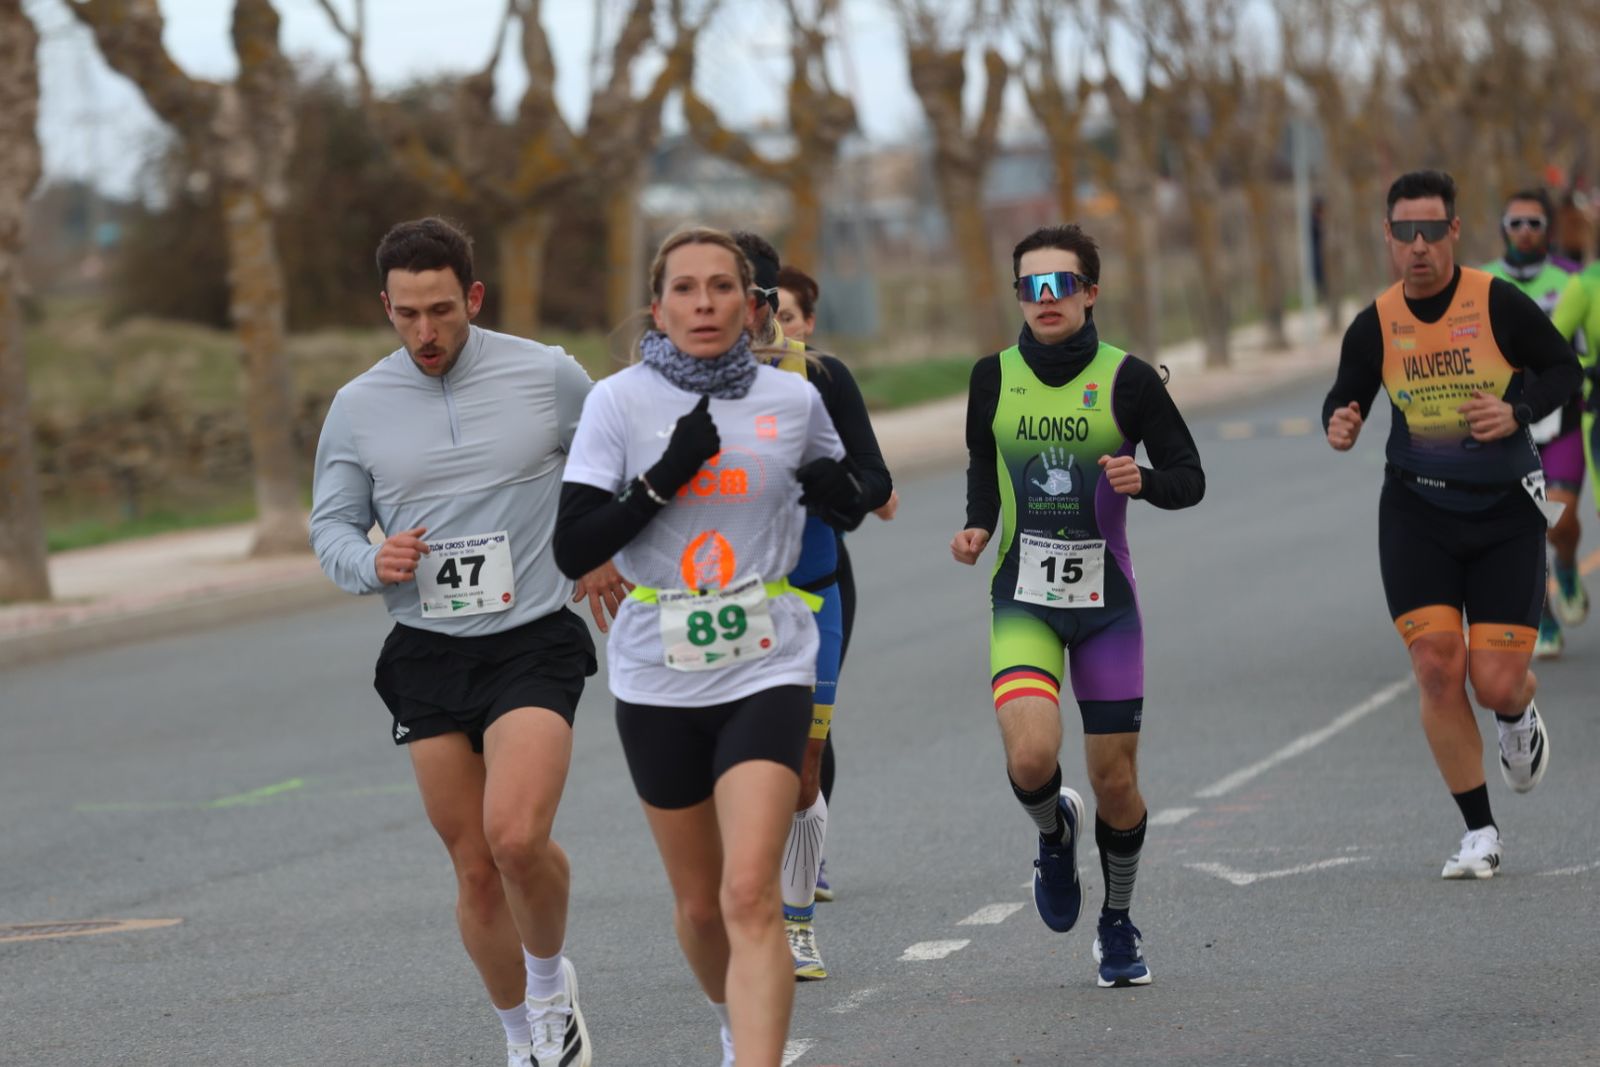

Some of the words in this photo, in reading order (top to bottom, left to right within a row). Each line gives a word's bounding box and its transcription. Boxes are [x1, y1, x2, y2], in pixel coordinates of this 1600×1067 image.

[1402, 348, 1475, 381] VALVERDE
[1016, 415, 1089, 441] ALONSO
[1417, 476, 1446, 488] KIPRUN
[1028, 502, 1056, 510] ROBERTO
[1057, 502, 1080, 510] RAMOS
[445, 541, 465, 550] CROSS
[436, 555, 486, 589] 47
[1040, 556, 1083, 584] 15
[687, 604, 748, 646] 89
